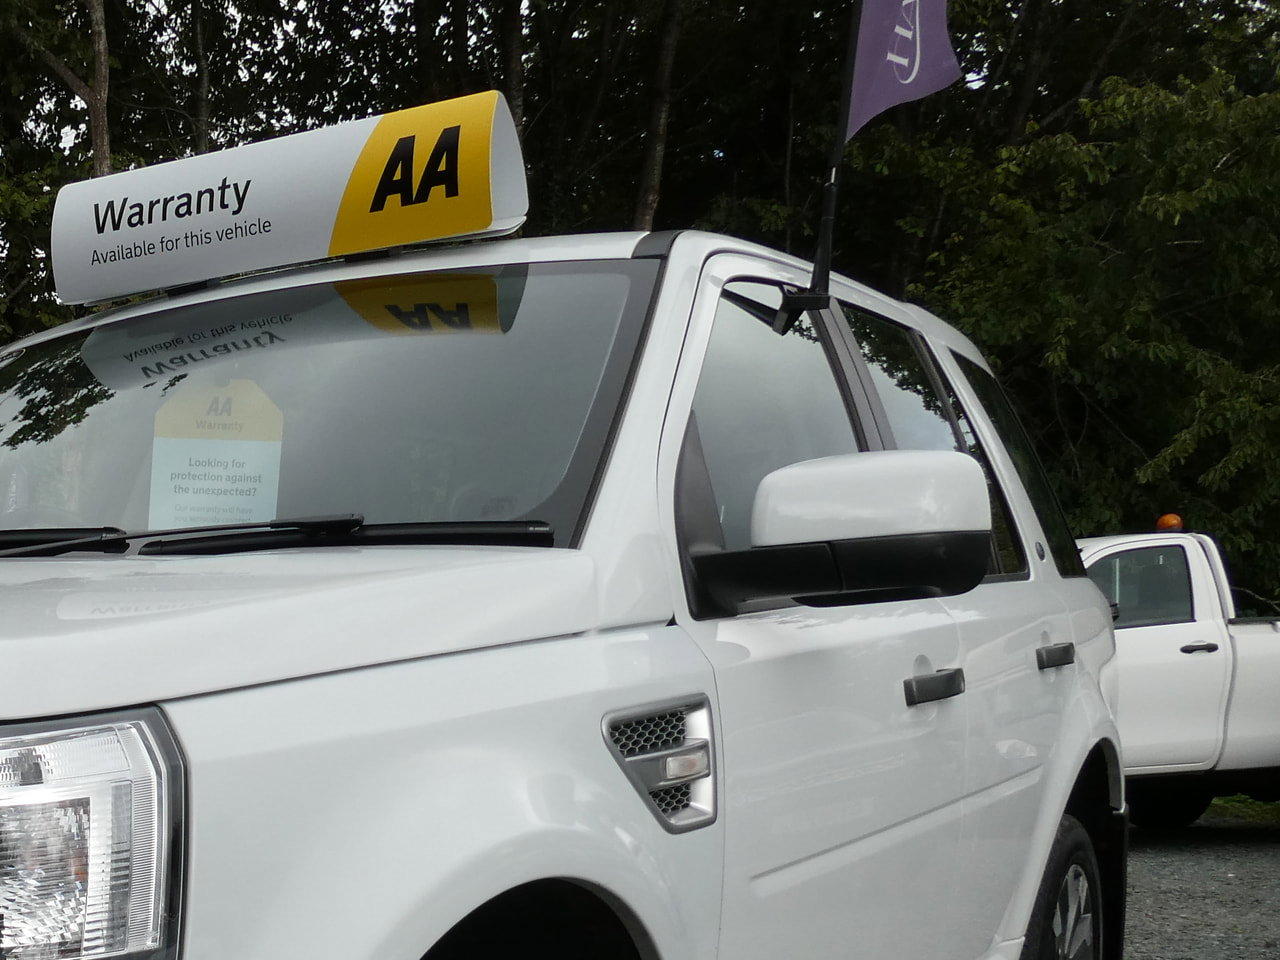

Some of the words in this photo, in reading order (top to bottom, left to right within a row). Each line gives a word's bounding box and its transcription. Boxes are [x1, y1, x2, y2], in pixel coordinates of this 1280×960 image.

[369, 125, 461, 213] AA
[94, 176, 252, 235] Warranty
[91, 240, 156, 266] Available
[160, 236, 181, 253] for
[184, 229, 212, 249] this
[215, 218, 272, 242] vehicle
[206, 396, 233, 417] AA
[195, 419, 244, 433] Warranty
[189, 457, 229, 470] Looking
[231, 459, 247, 469] for
[170, 471, 222, 483] protection
[225, 473, 262, 484] against
[173, 484, 190, 494] the
[192, 486, 258, 497] unexpected?
